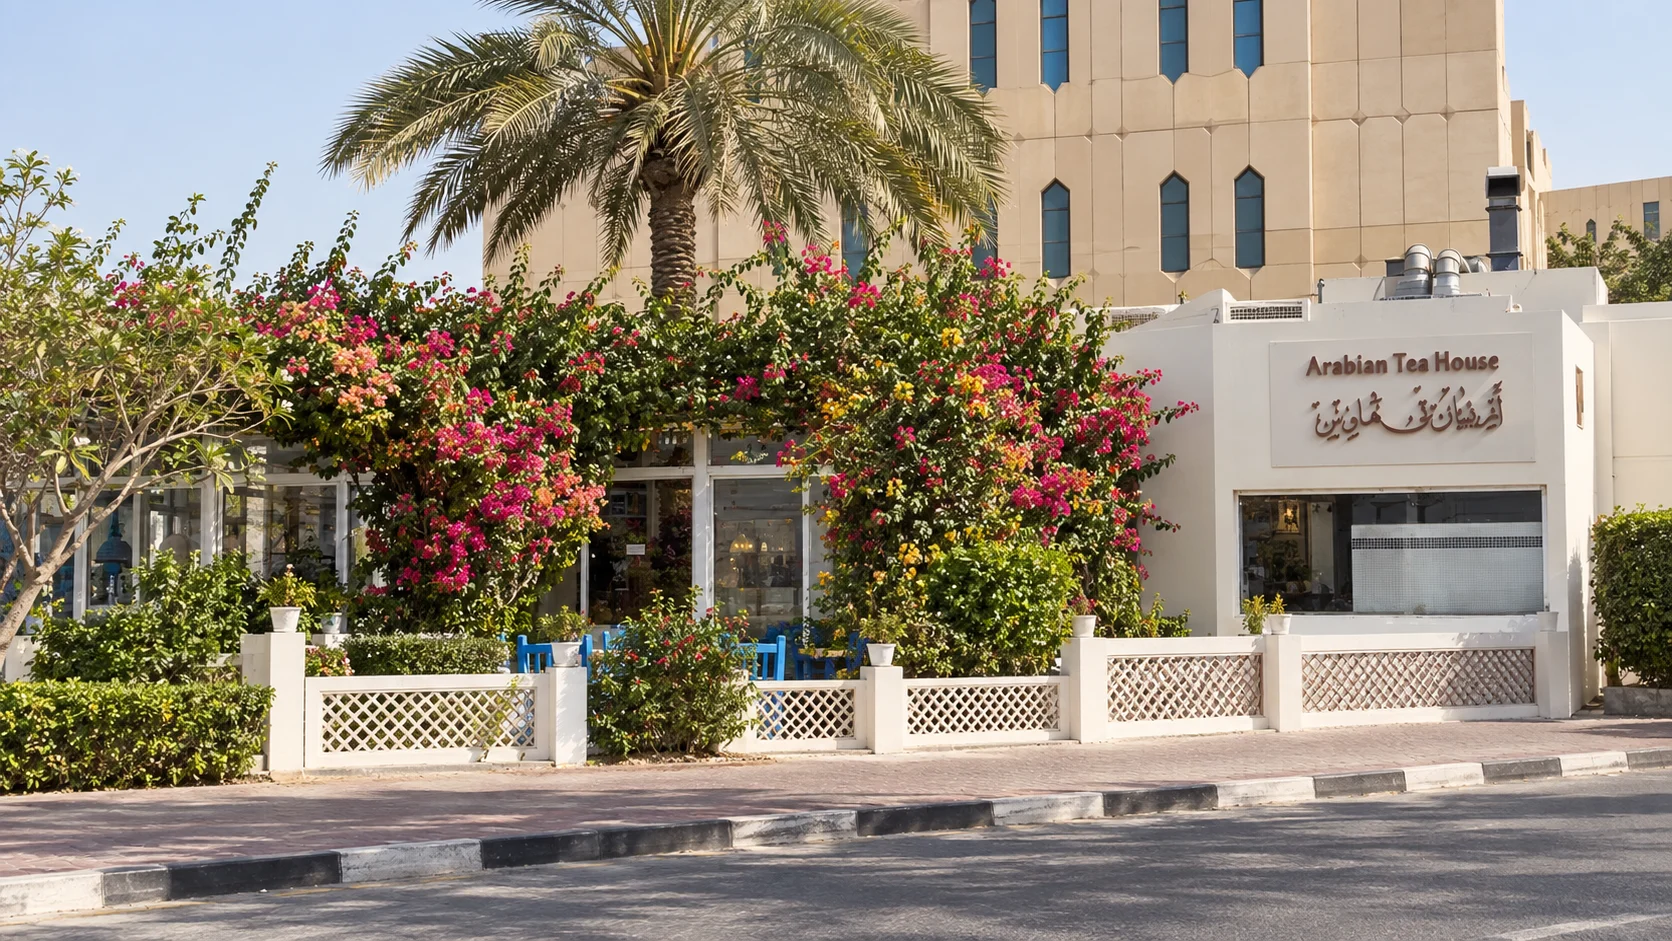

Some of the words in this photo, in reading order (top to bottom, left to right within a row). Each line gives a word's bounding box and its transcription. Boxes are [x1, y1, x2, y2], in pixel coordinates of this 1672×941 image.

[1305, 354, 1388, 377] Arabian
[1392, 352, 1430, 374] Tea
[1434, 350, 1500, 372] House
